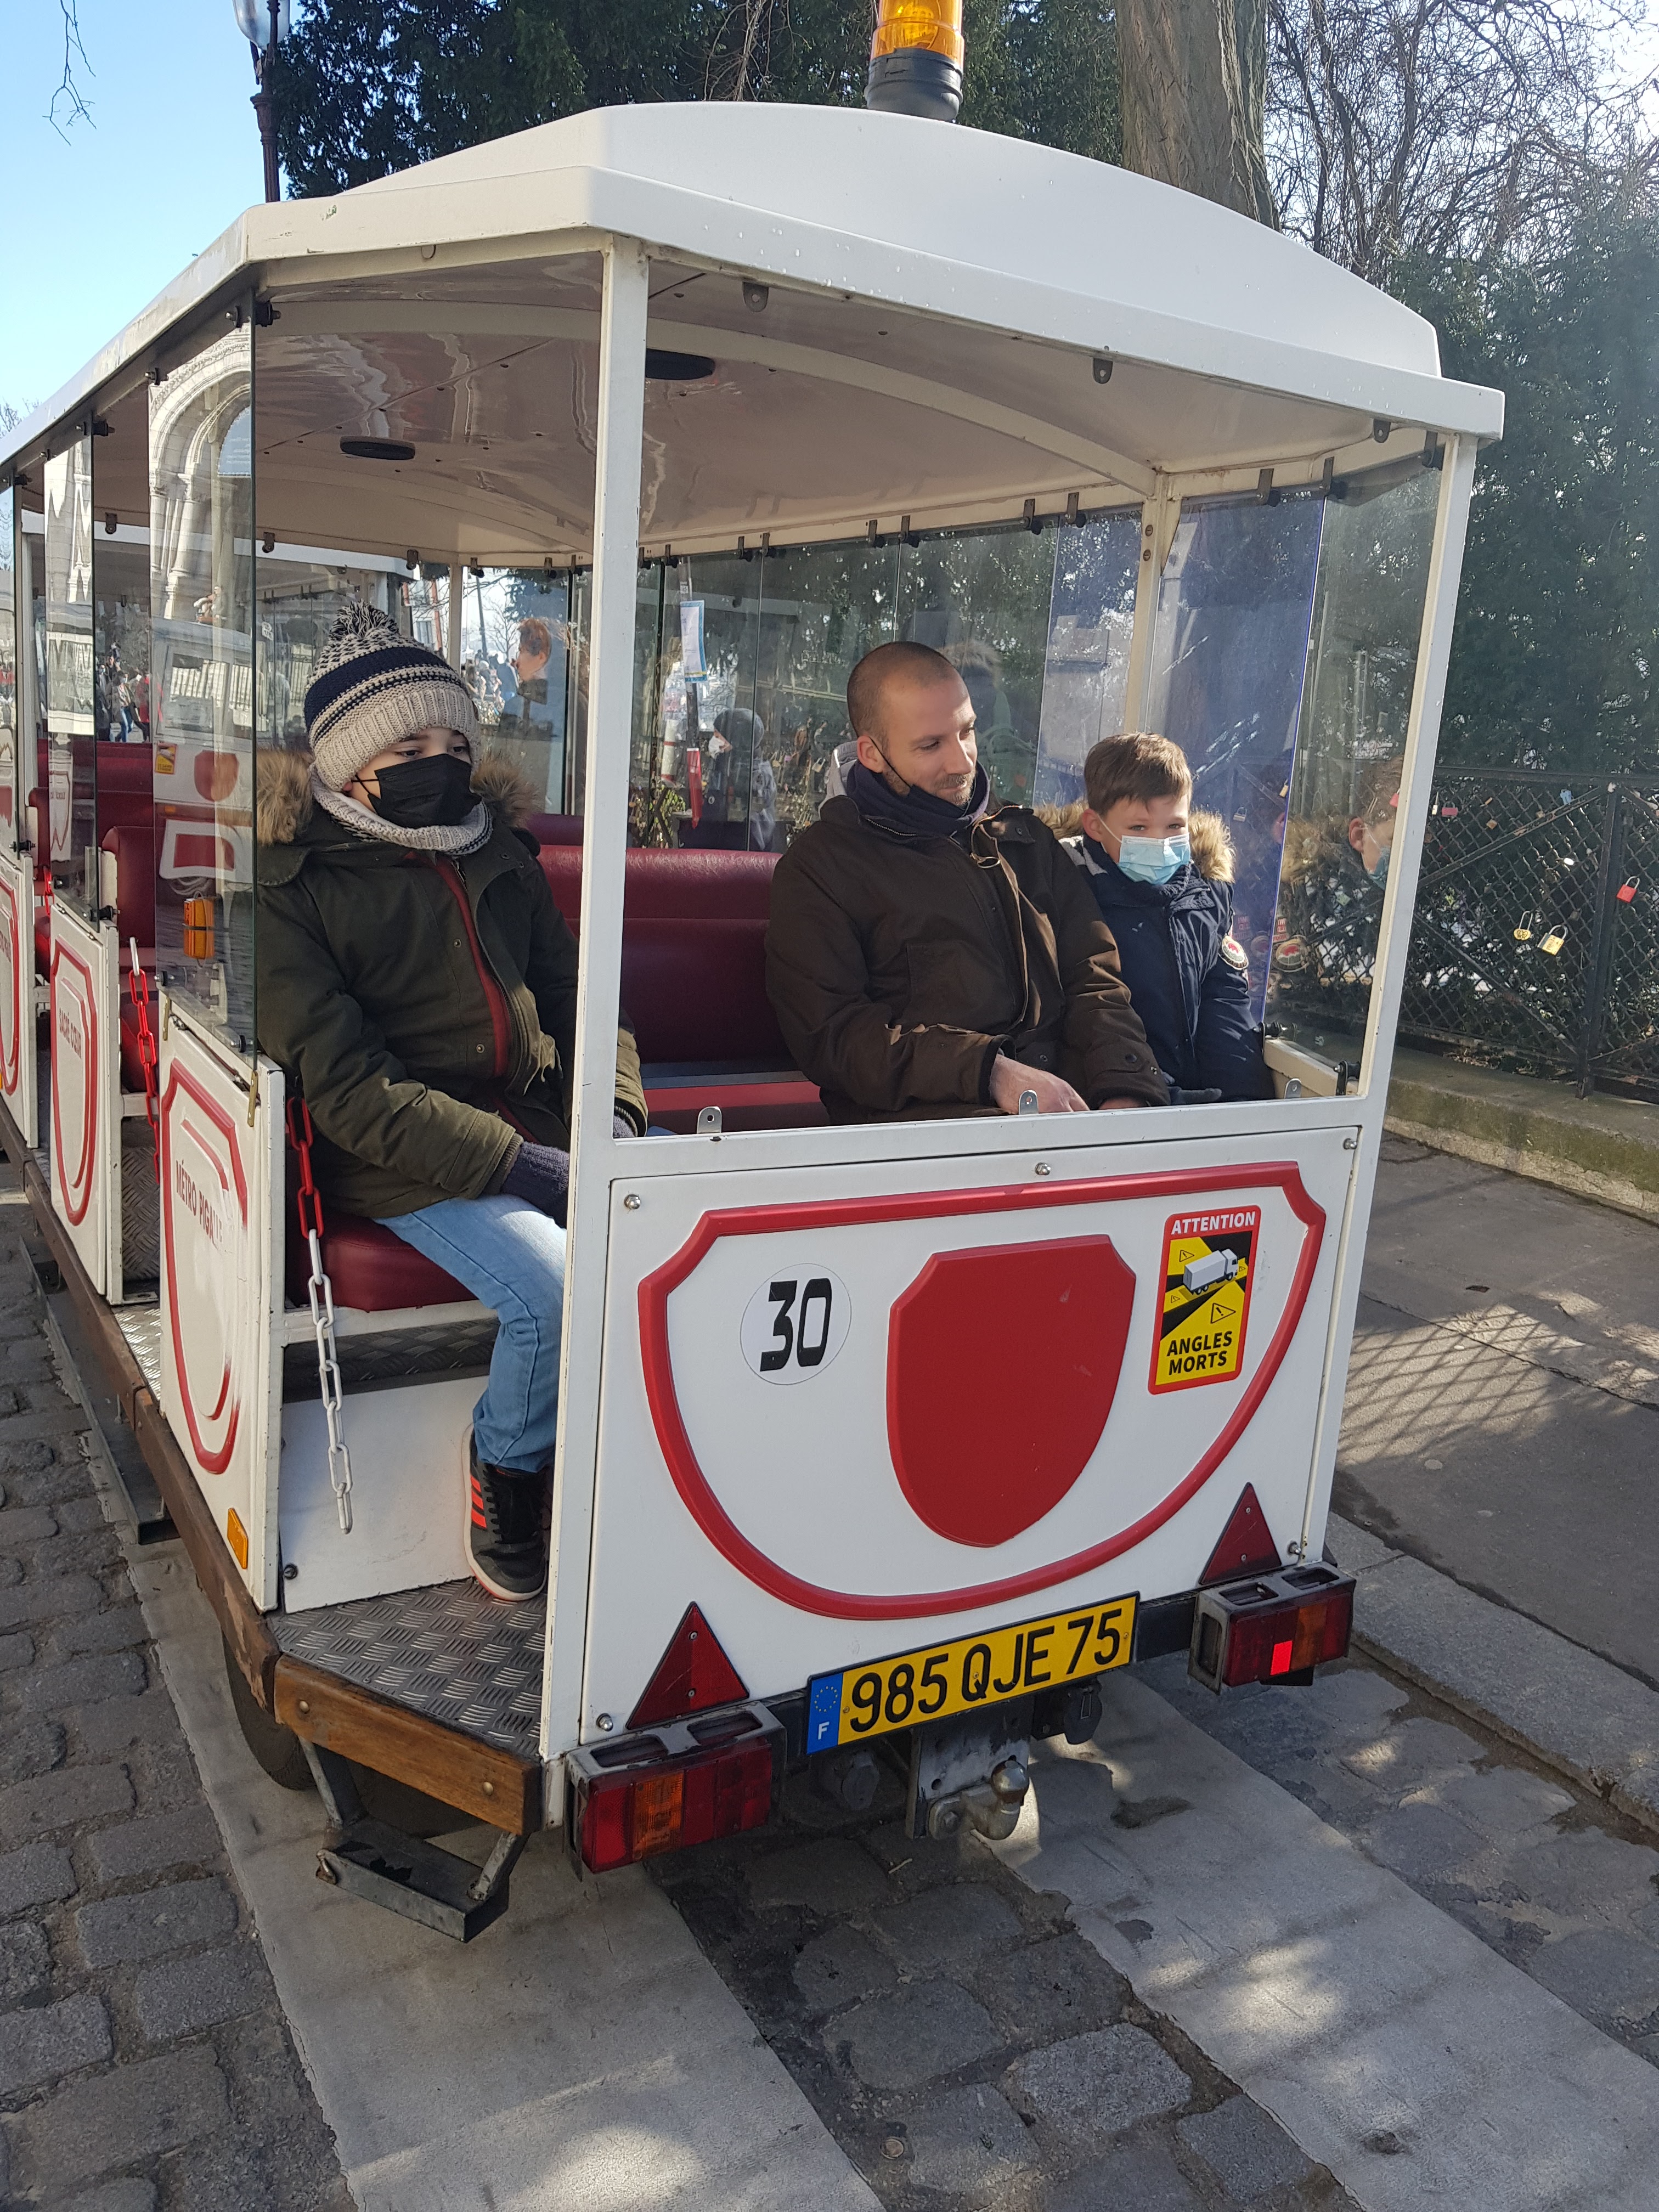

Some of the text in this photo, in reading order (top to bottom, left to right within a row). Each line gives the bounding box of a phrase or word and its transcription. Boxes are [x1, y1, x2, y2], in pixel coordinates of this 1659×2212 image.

[176, 1158, 197, 1217] MÉTRO
[1171, 1211, 1256, 1235] ATTENTION
[759, 1277, 832, 1372] 30
[1166, 1330, 1233, 1357] ANGLES
[1168, 1350, 1228, 1376] MORTS
[849, 1607, 1122, 1733] 985 QJE 75
[817, 1721, 830, 1741] F
